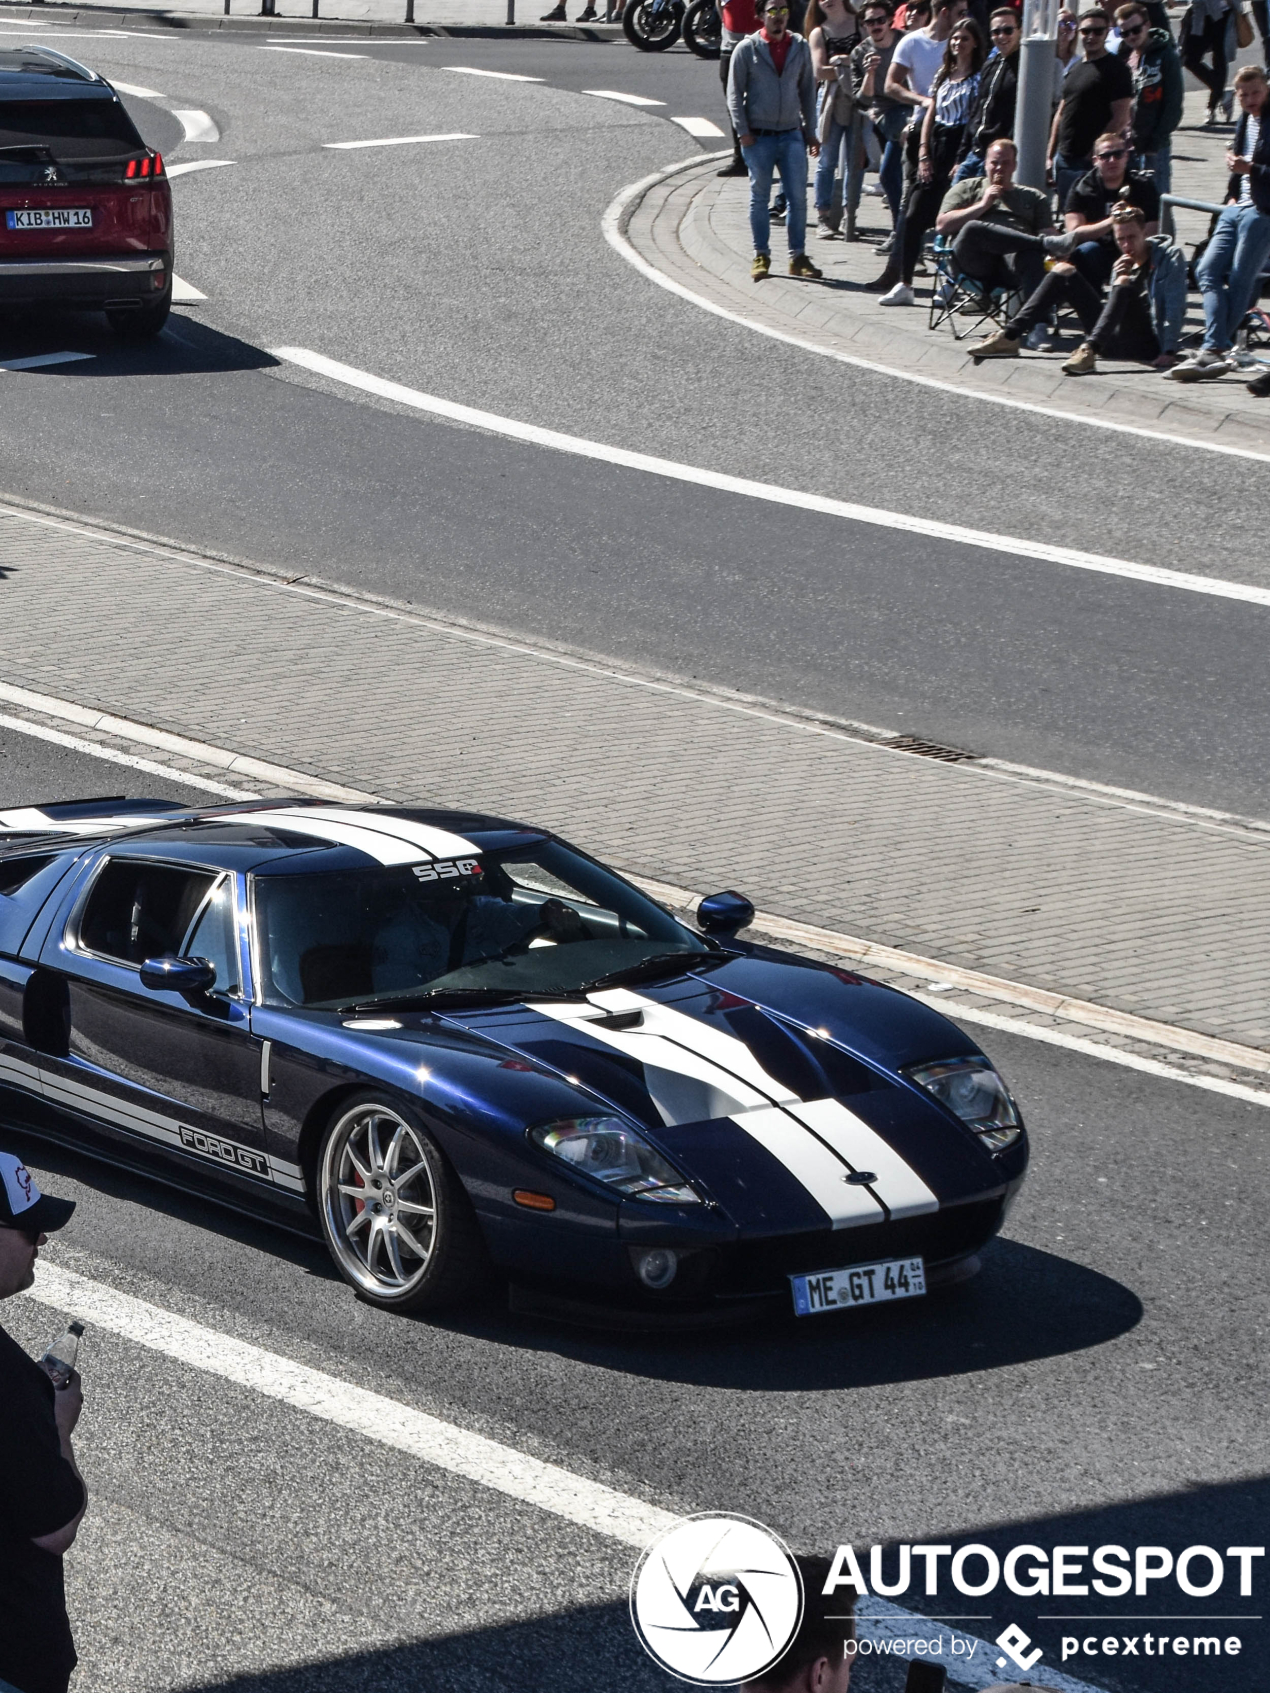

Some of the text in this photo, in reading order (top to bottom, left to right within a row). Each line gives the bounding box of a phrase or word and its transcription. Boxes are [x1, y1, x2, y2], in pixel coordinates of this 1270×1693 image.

[16, 211, 91, 226] KIB HW 16
[180, 1128, 265, 1172] FORD GT
[808, 1276, 837, 1308] ME
[849, 1268, 876, 1302] GT
[884, 1264, 910, 1295] 44
